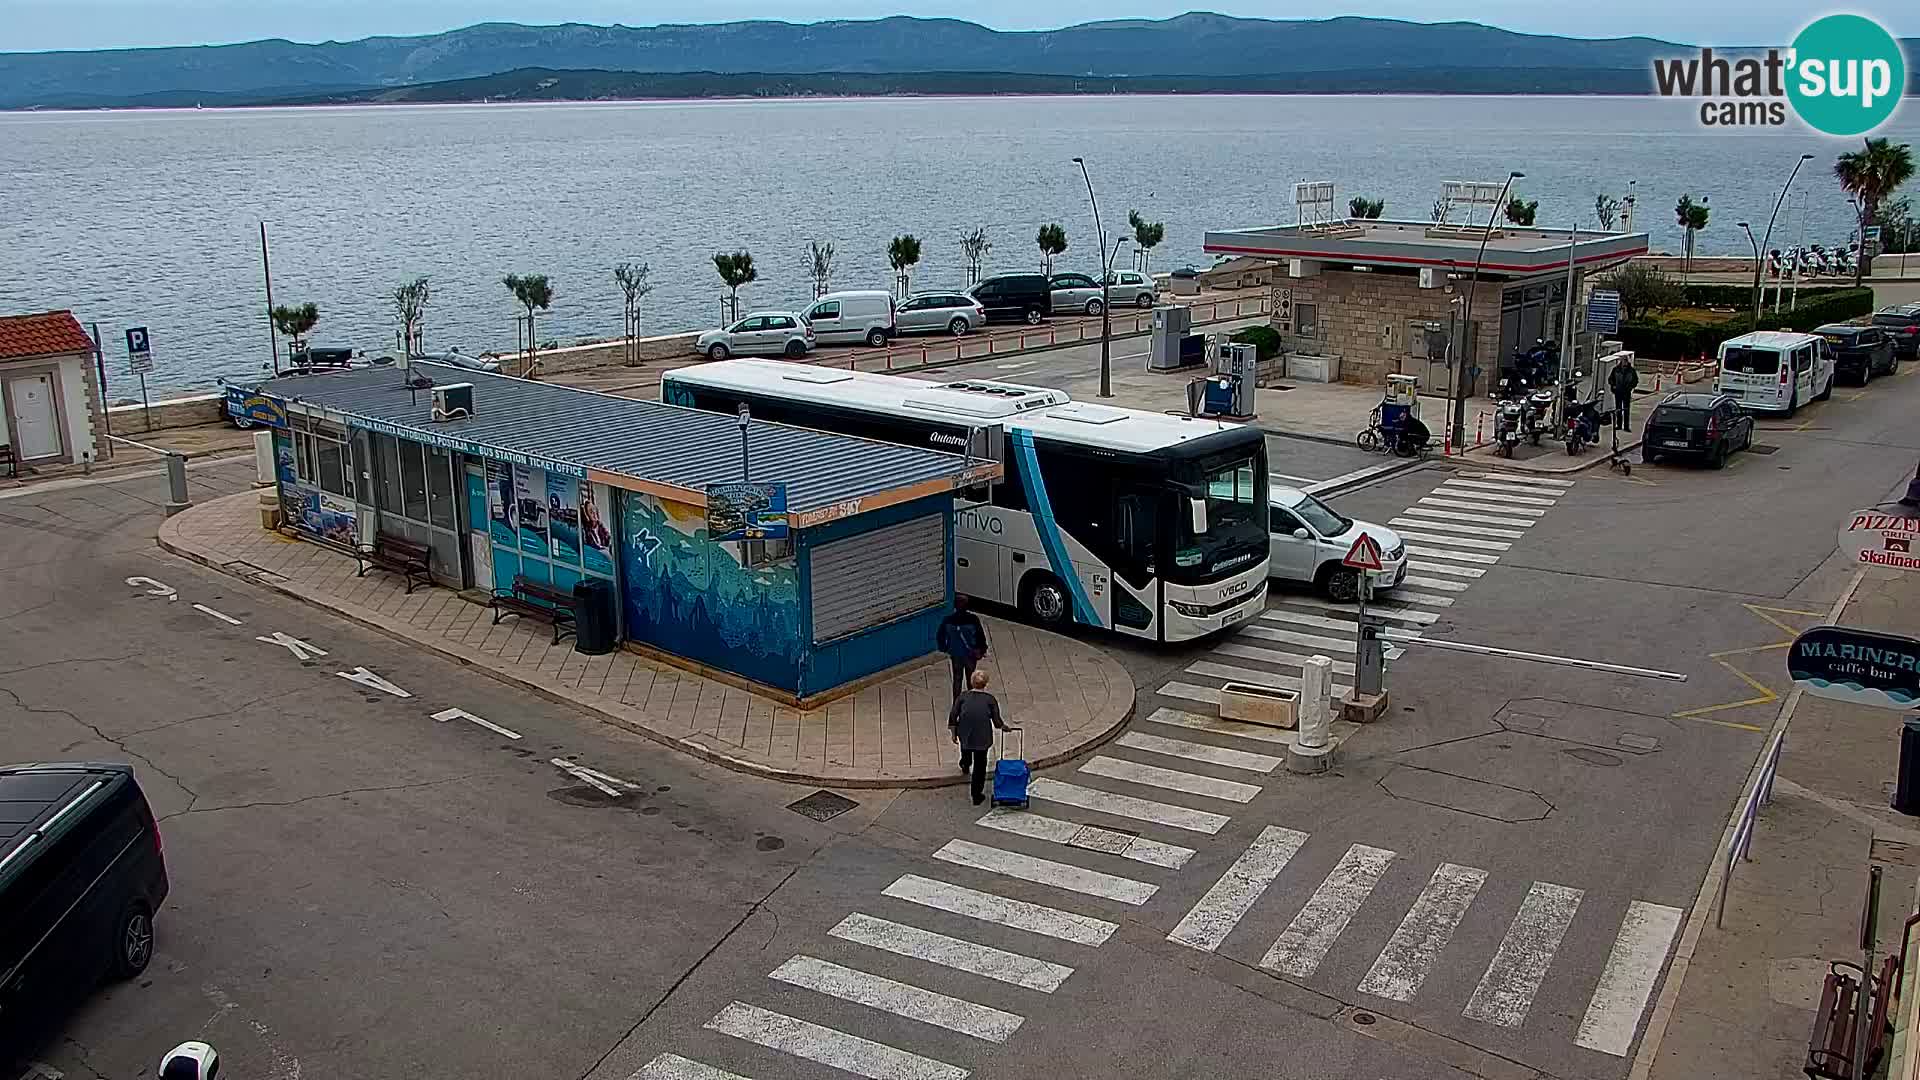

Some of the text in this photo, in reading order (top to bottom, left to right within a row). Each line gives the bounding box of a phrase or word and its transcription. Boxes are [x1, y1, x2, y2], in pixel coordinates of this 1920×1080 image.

[437, 436, 469, 452] POSTAJA
[479, 446, 494, 458] BUS
[495, 449, 527, 465] STATION
[529, 456, 556, 471] TICKET
[556, 463, 584, 477] OFFICE
[1847, 514, 1920, 534] PIZZE
[1881, 530, 1917, 540] GRILL
[1218, 580, 1248, 599] IVECO
[1828, 661, 1897, 680] caffe bar
